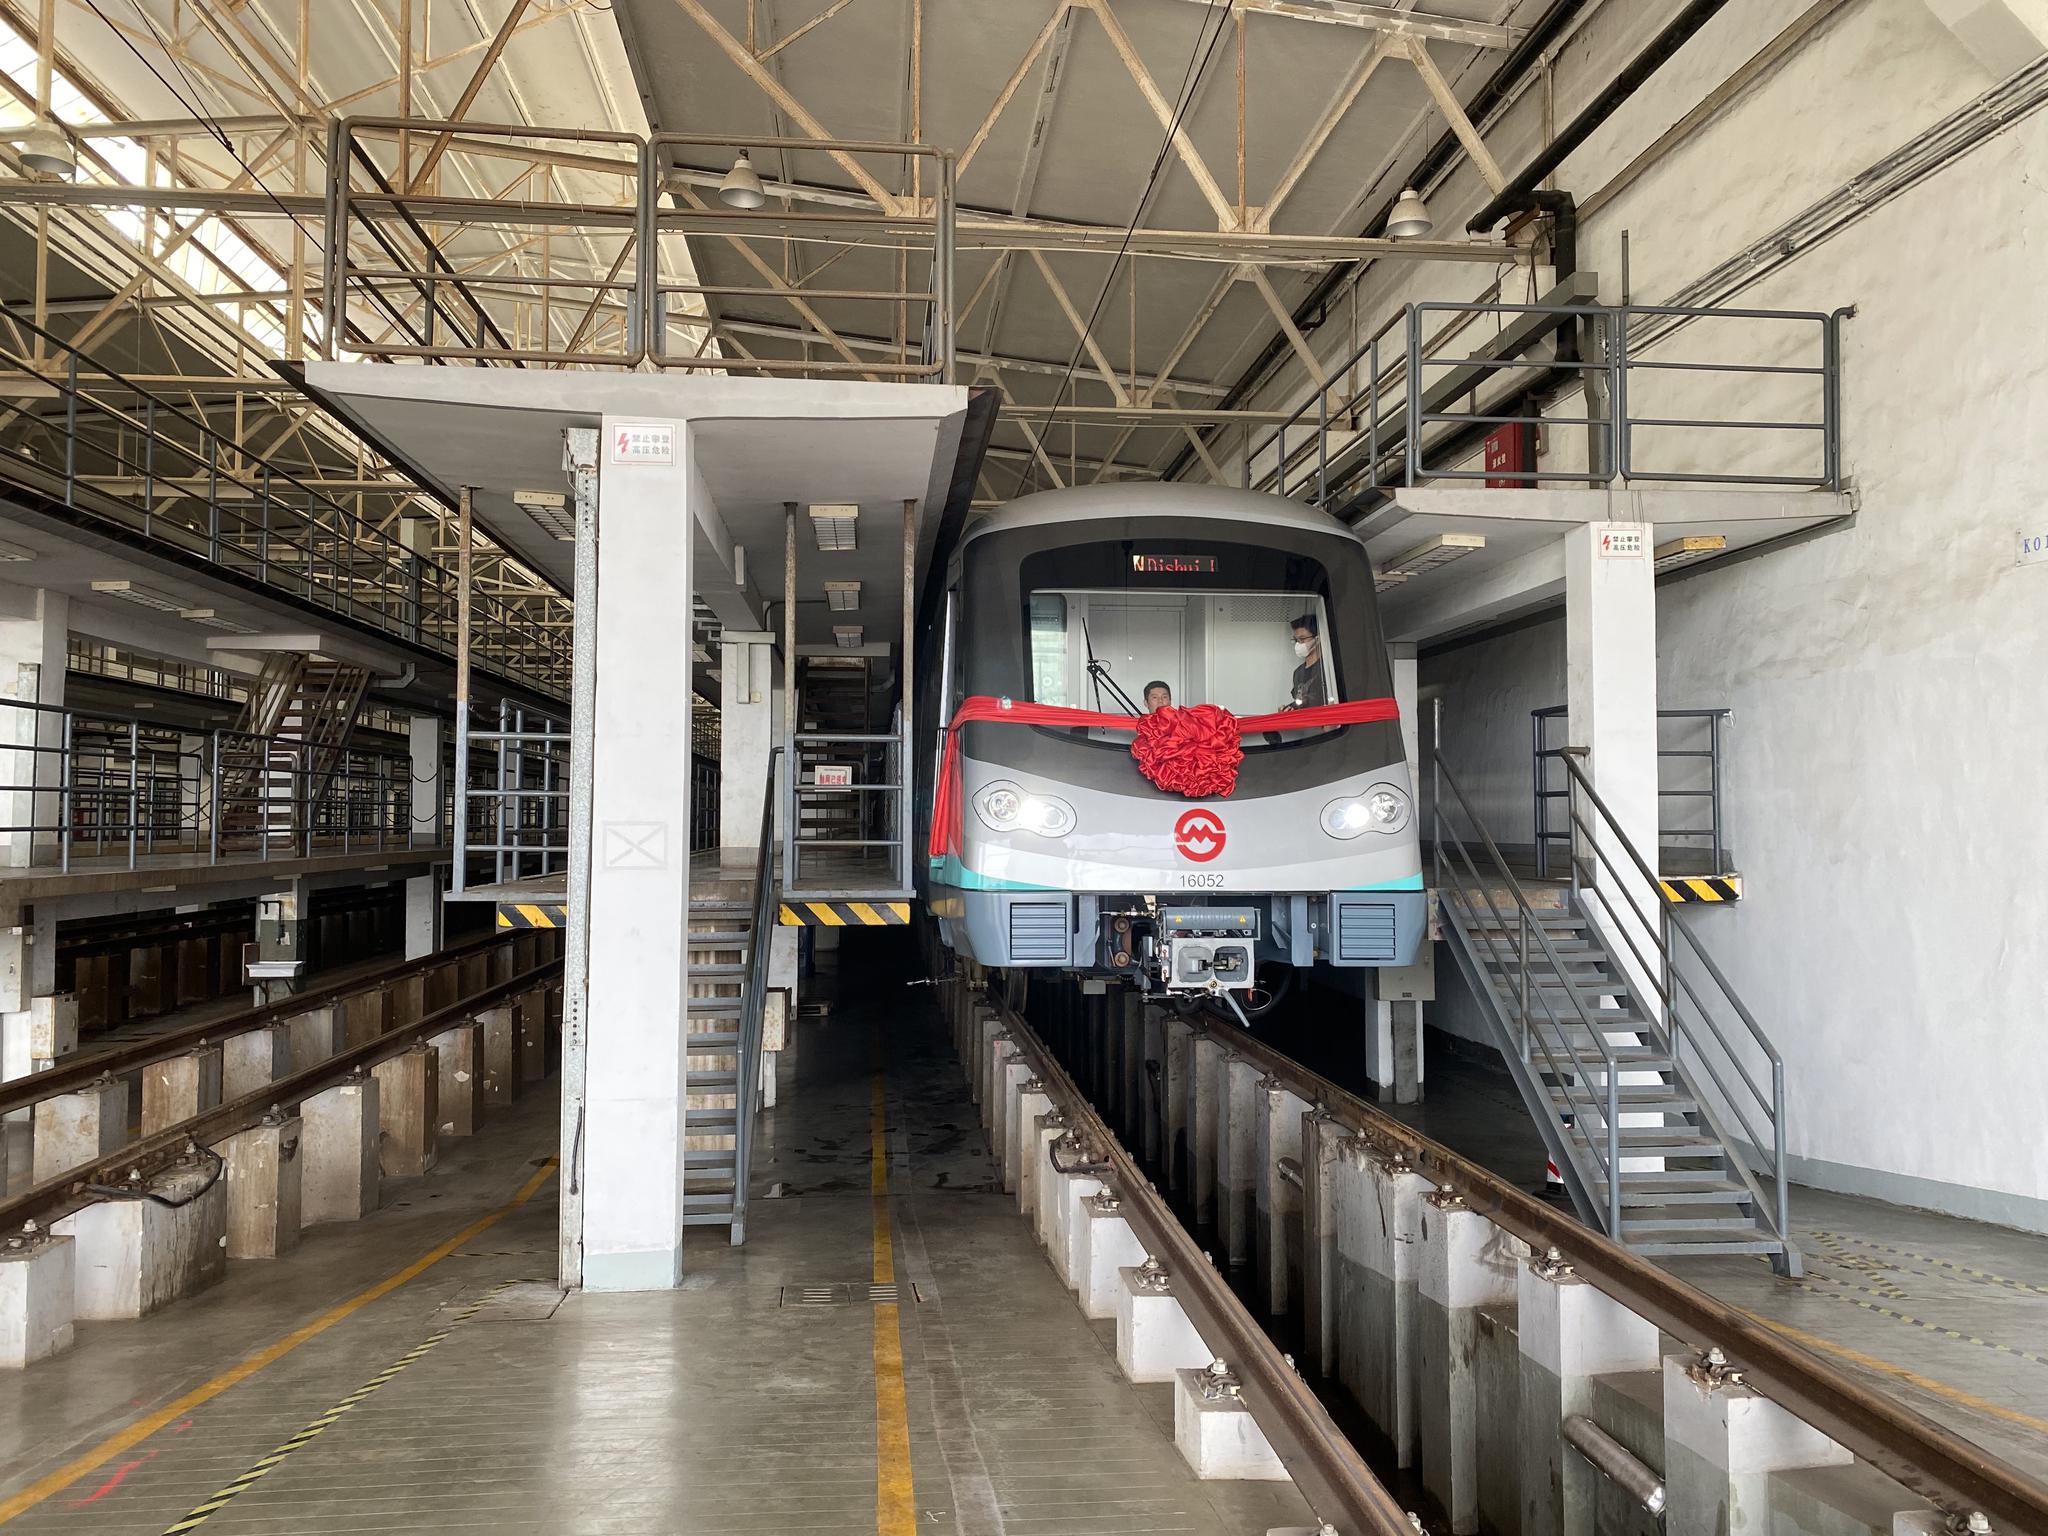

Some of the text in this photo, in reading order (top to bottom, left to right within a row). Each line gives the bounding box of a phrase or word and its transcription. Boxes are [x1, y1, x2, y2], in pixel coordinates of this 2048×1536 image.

[631, 445, 670, 455] 高压危险
[1179, 874, 1224, 888] 16052
